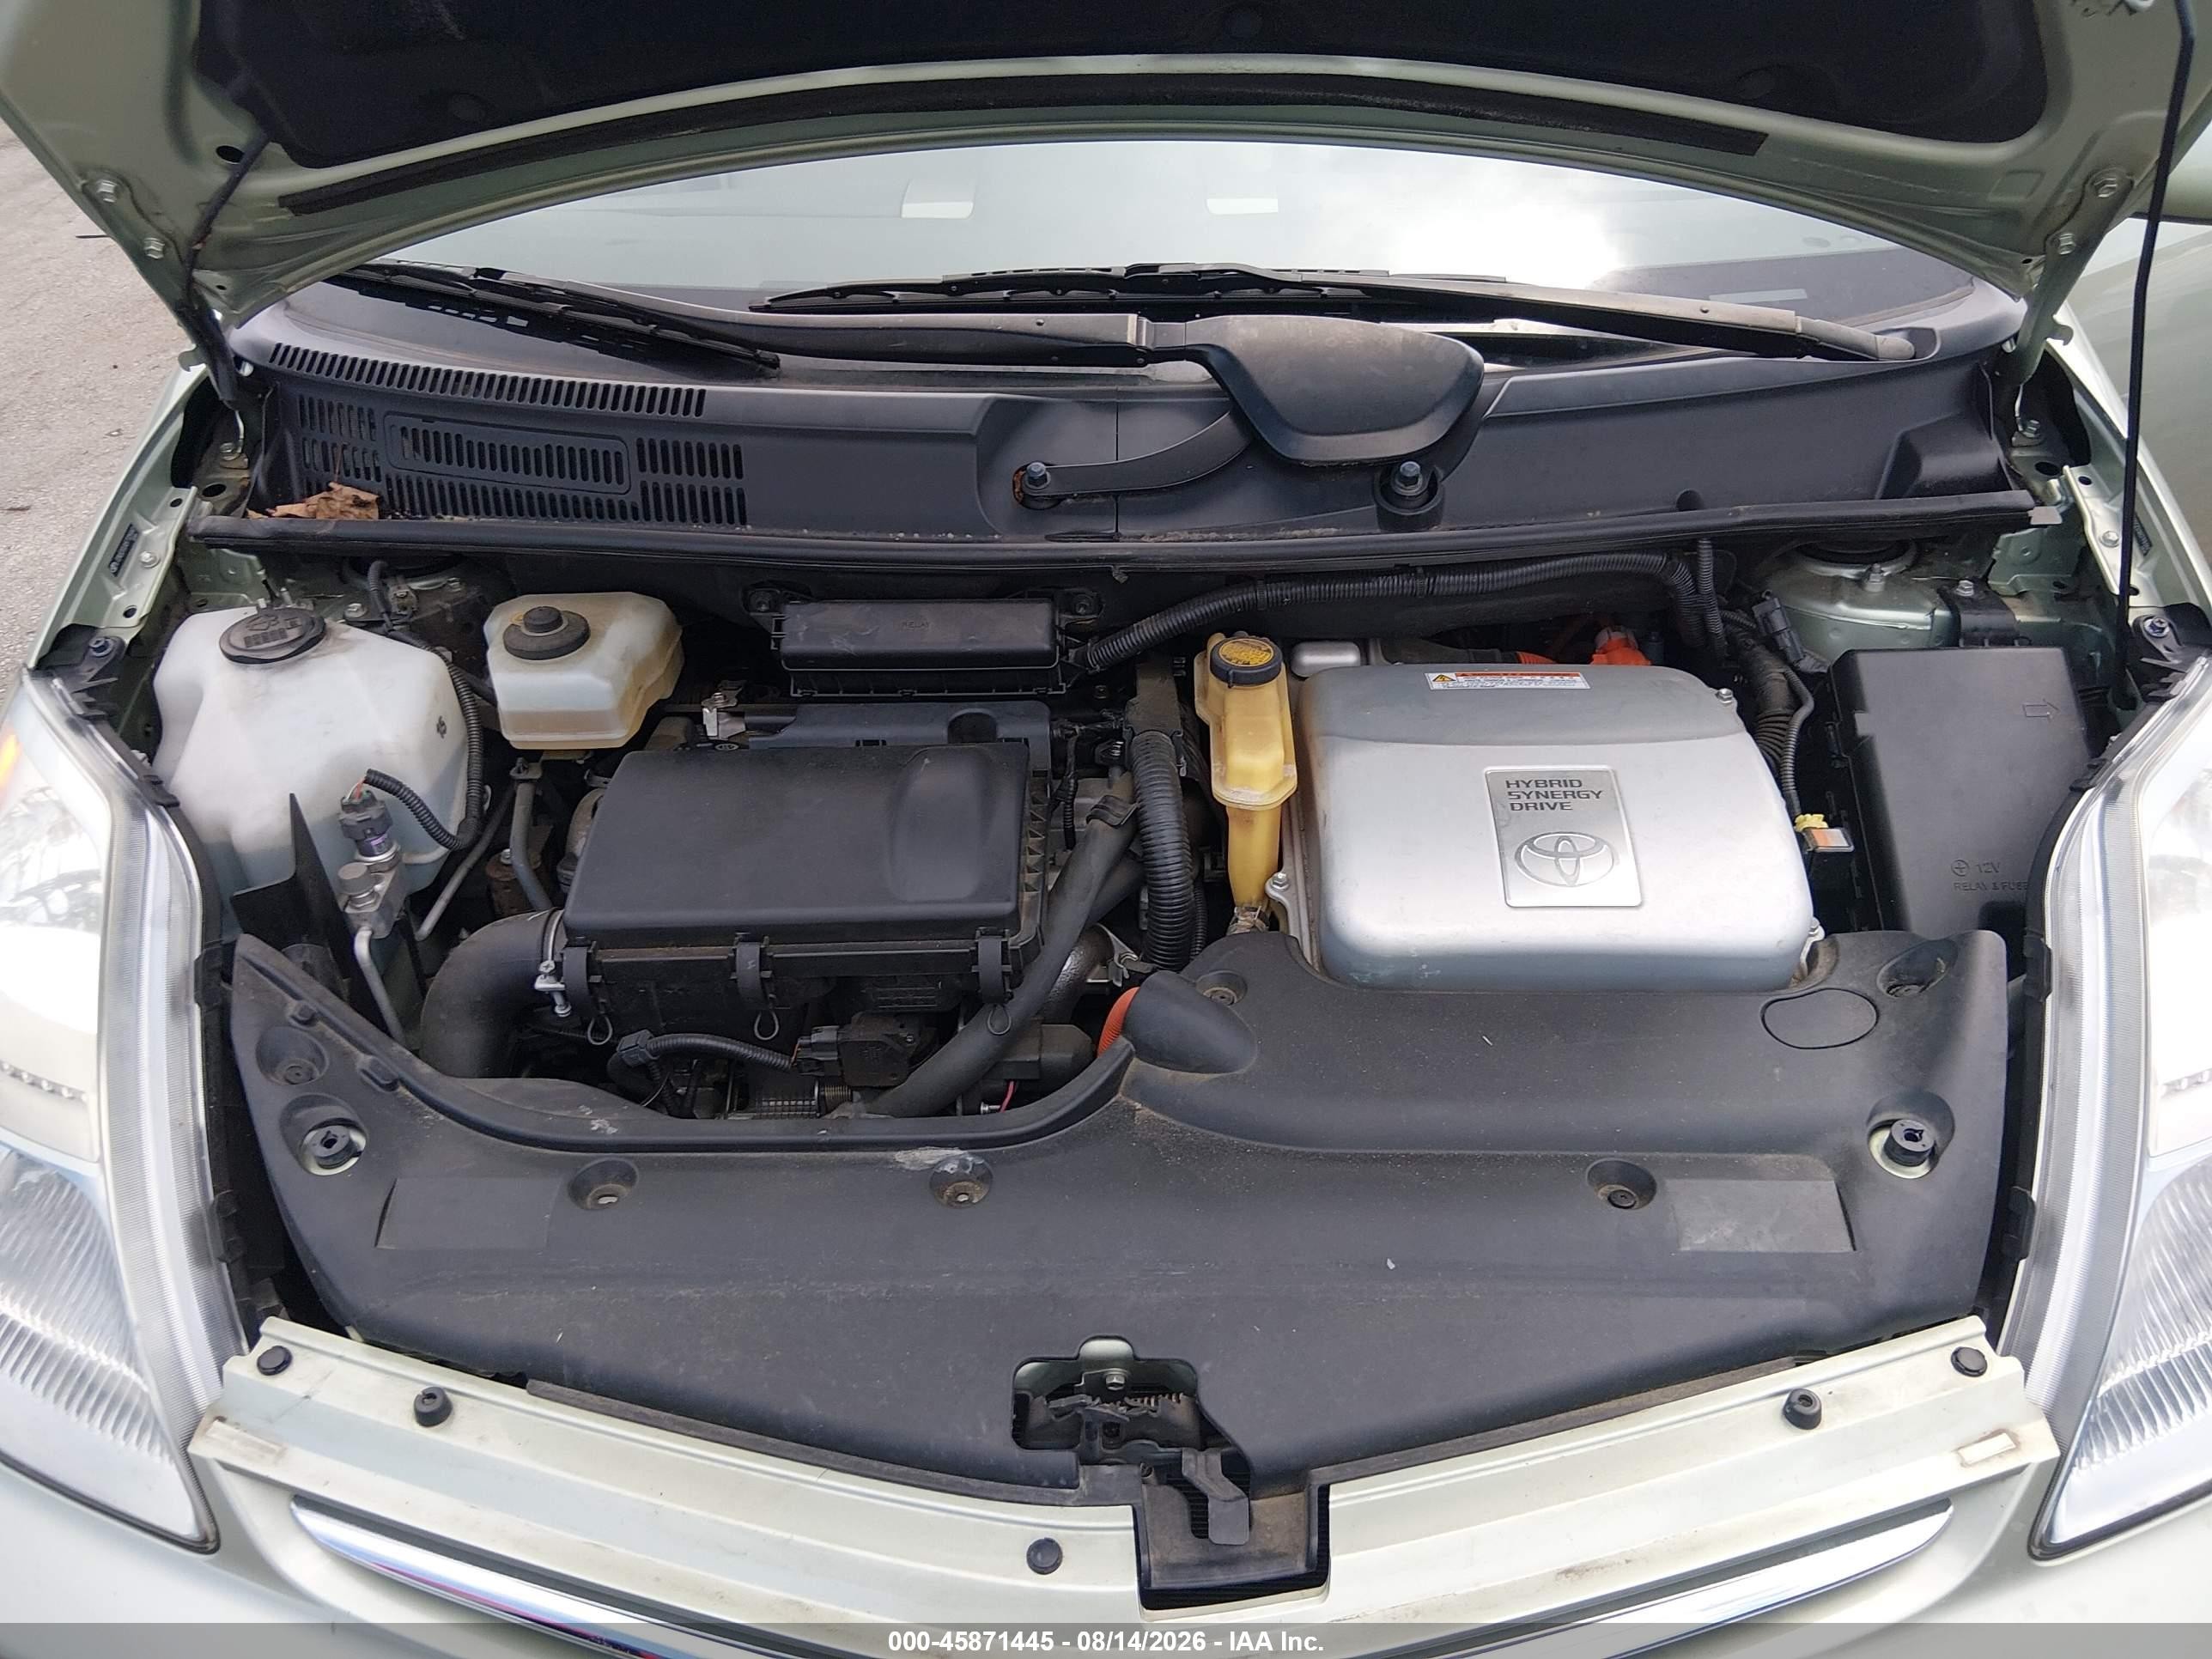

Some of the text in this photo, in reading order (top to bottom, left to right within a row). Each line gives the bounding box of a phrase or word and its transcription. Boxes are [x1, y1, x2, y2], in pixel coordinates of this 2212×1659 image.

[1505, 779, 1583, 788] HYBRID
[1507, 790, 1603, 799] SYNERGY
[1509, 801, 1573, 811] DRIVE
[1954, 881, 1987, 891] RELAY
